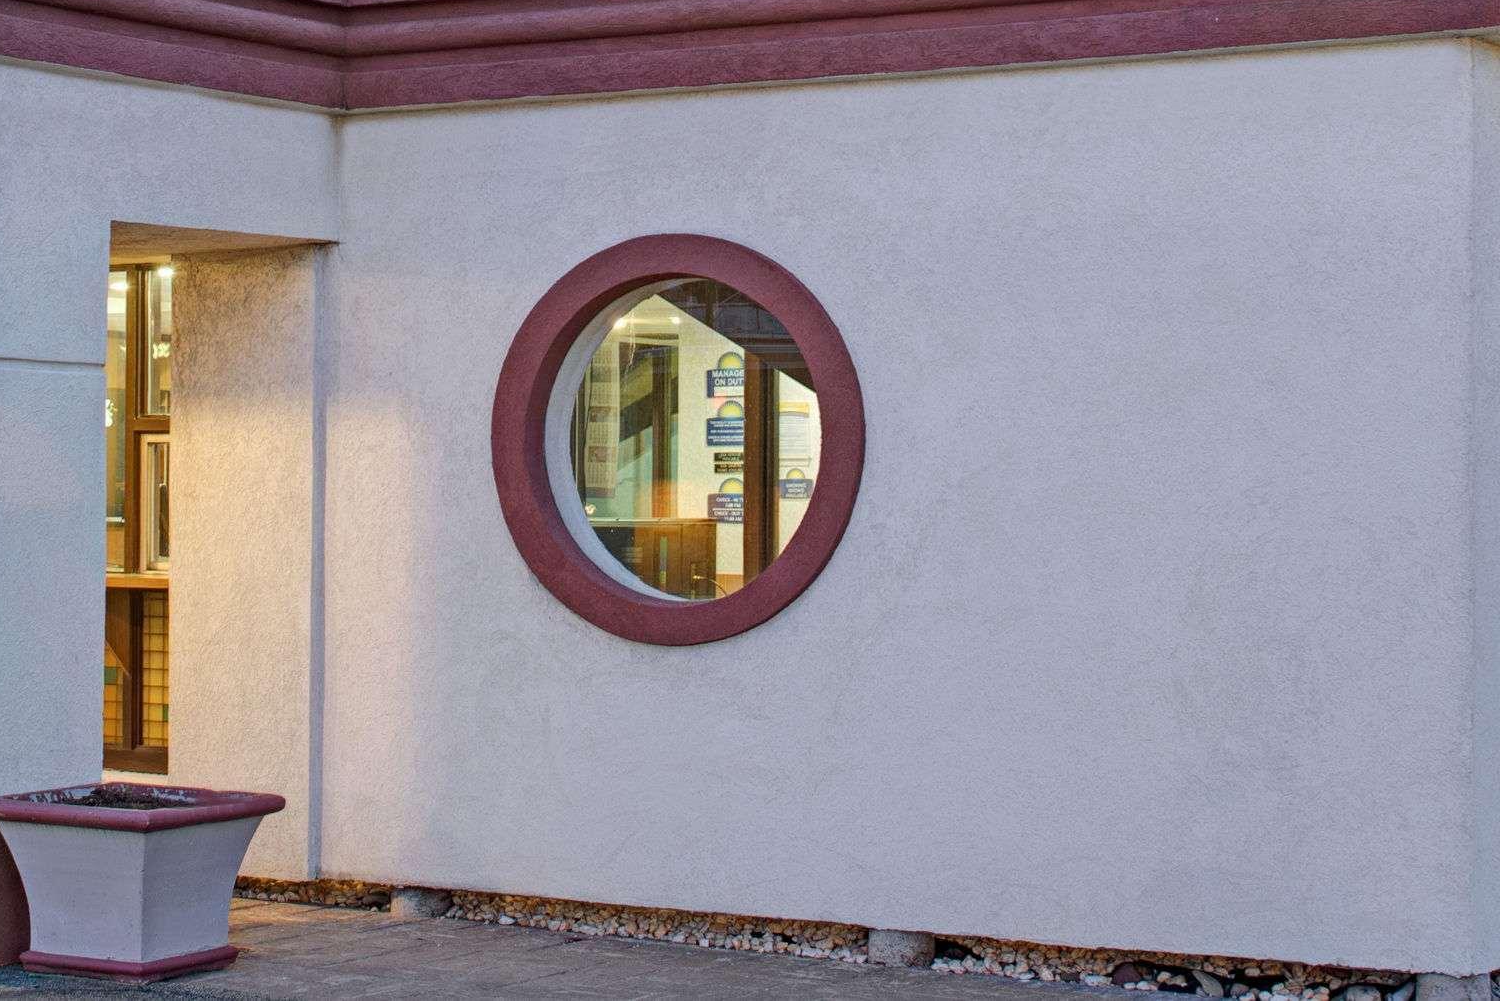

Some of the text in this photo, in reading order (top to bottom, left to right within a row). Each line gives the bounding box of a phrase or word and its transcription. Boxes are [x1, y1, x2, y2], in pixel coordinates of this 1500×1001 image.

[711, 369, 744, 378] MANAGE
[714, 377, 744, 386] ON DUT
